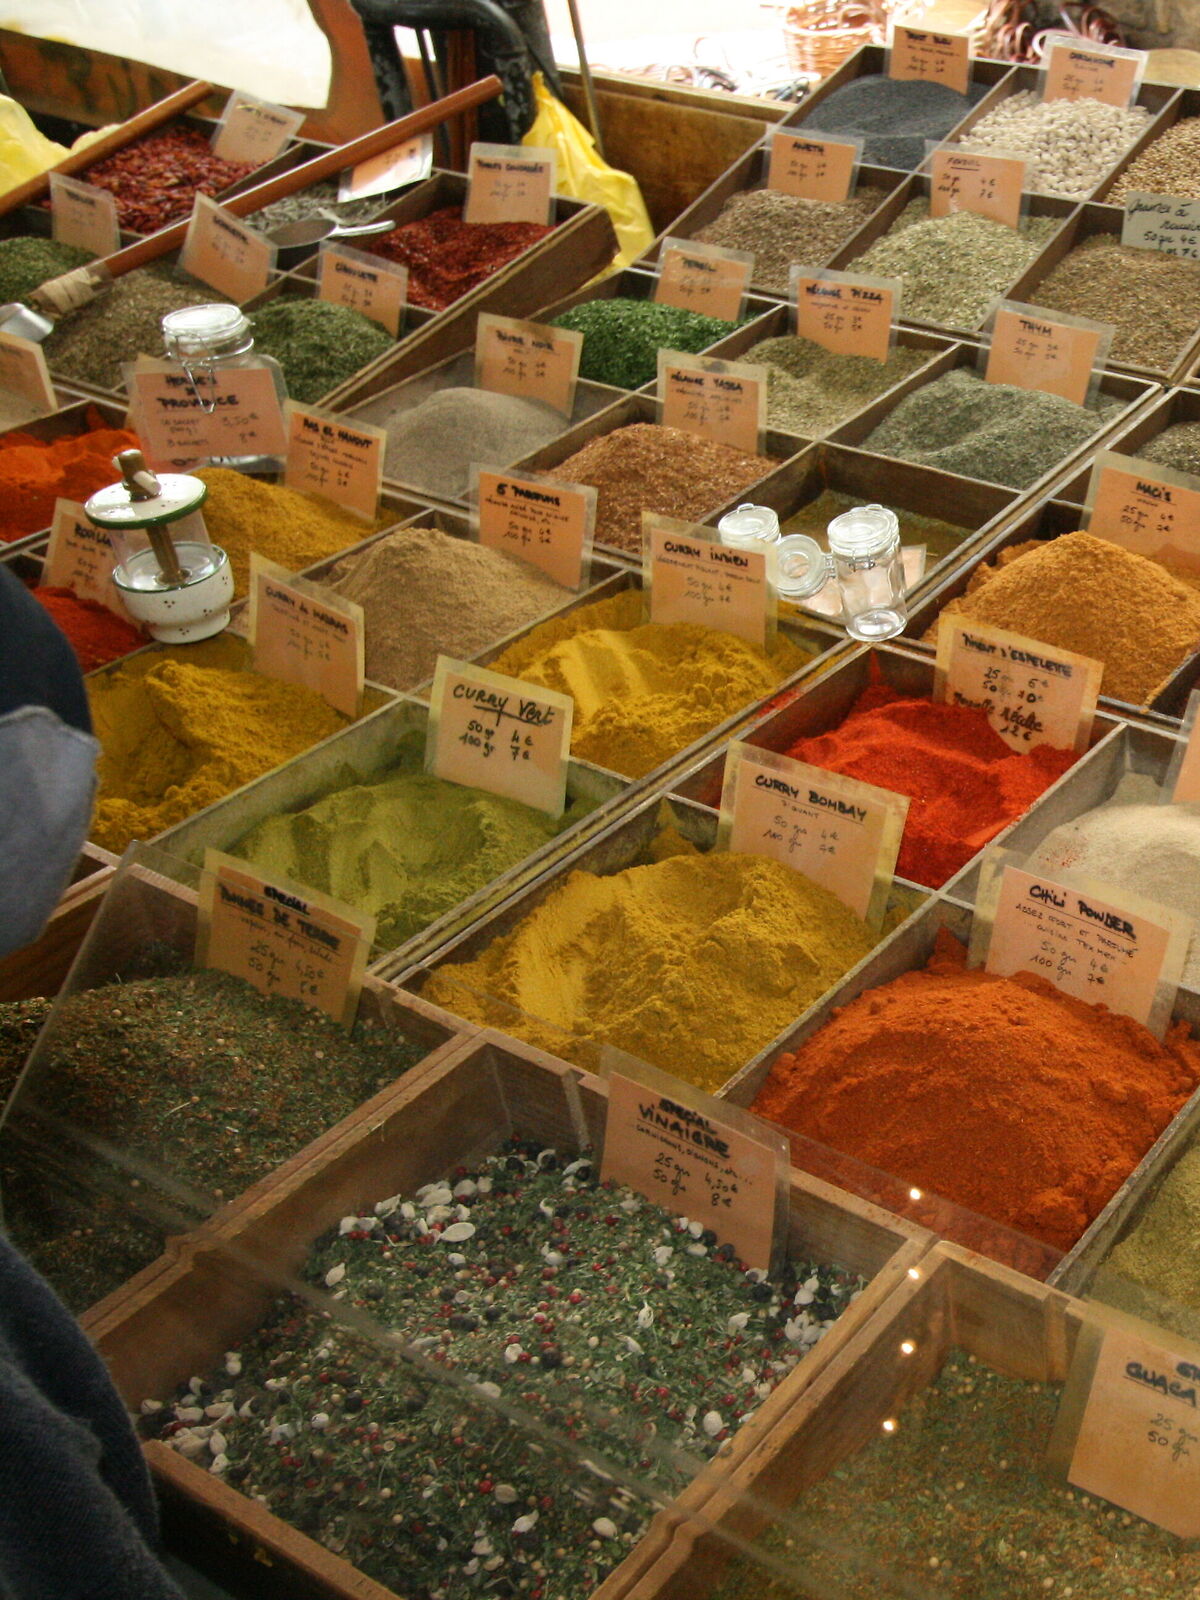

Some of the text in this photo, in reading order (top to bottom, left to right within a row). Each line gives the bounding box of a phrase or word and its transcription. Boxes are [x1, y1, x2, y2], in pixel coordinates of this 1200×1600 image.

[664, 541, 701, 558] CURRY
[452, 683, 510, 727] CURRY
[754, 774, 868, 822] CURRY BOMBAY
[1077, 900, 1137, 941] POWDER
[655, 1151, 673, 1171] 25
[651, 1168, 668, 1183] 50
[1147, 1430, 1169, 1447] 50
